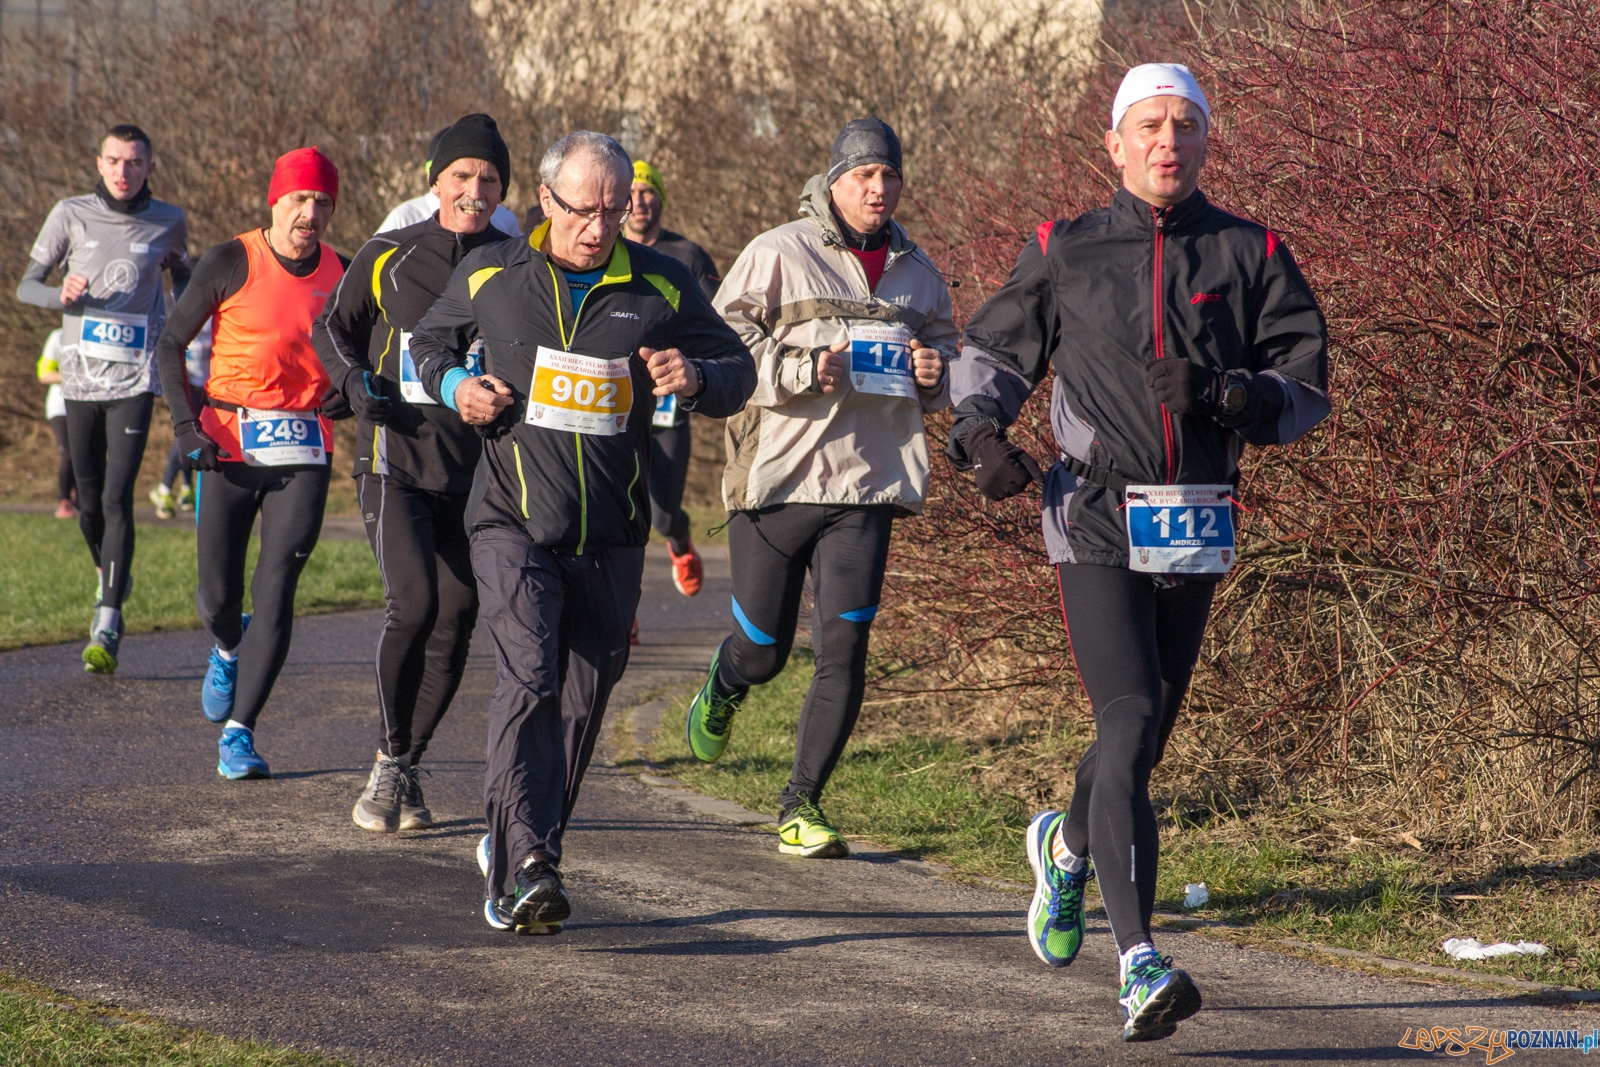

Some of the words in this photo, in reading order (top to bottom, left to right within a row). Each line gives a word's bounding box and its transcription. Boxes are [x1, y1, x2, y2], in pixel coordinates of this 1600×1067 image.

[610, 311, 634, 319] CRAFT
[93, 323, 135, 343] 409
[550, 354, 567, 363] XXXII
[568, 358, 583, 366] BIEG
[562, 364, 597, 375] RYSZARDA
[884, 367, 906, 375] MARCIN
[551, 375, 618, 408] 902
[256, 419, 308, 443] 249
[1152, 508, 1219, 538] 112
